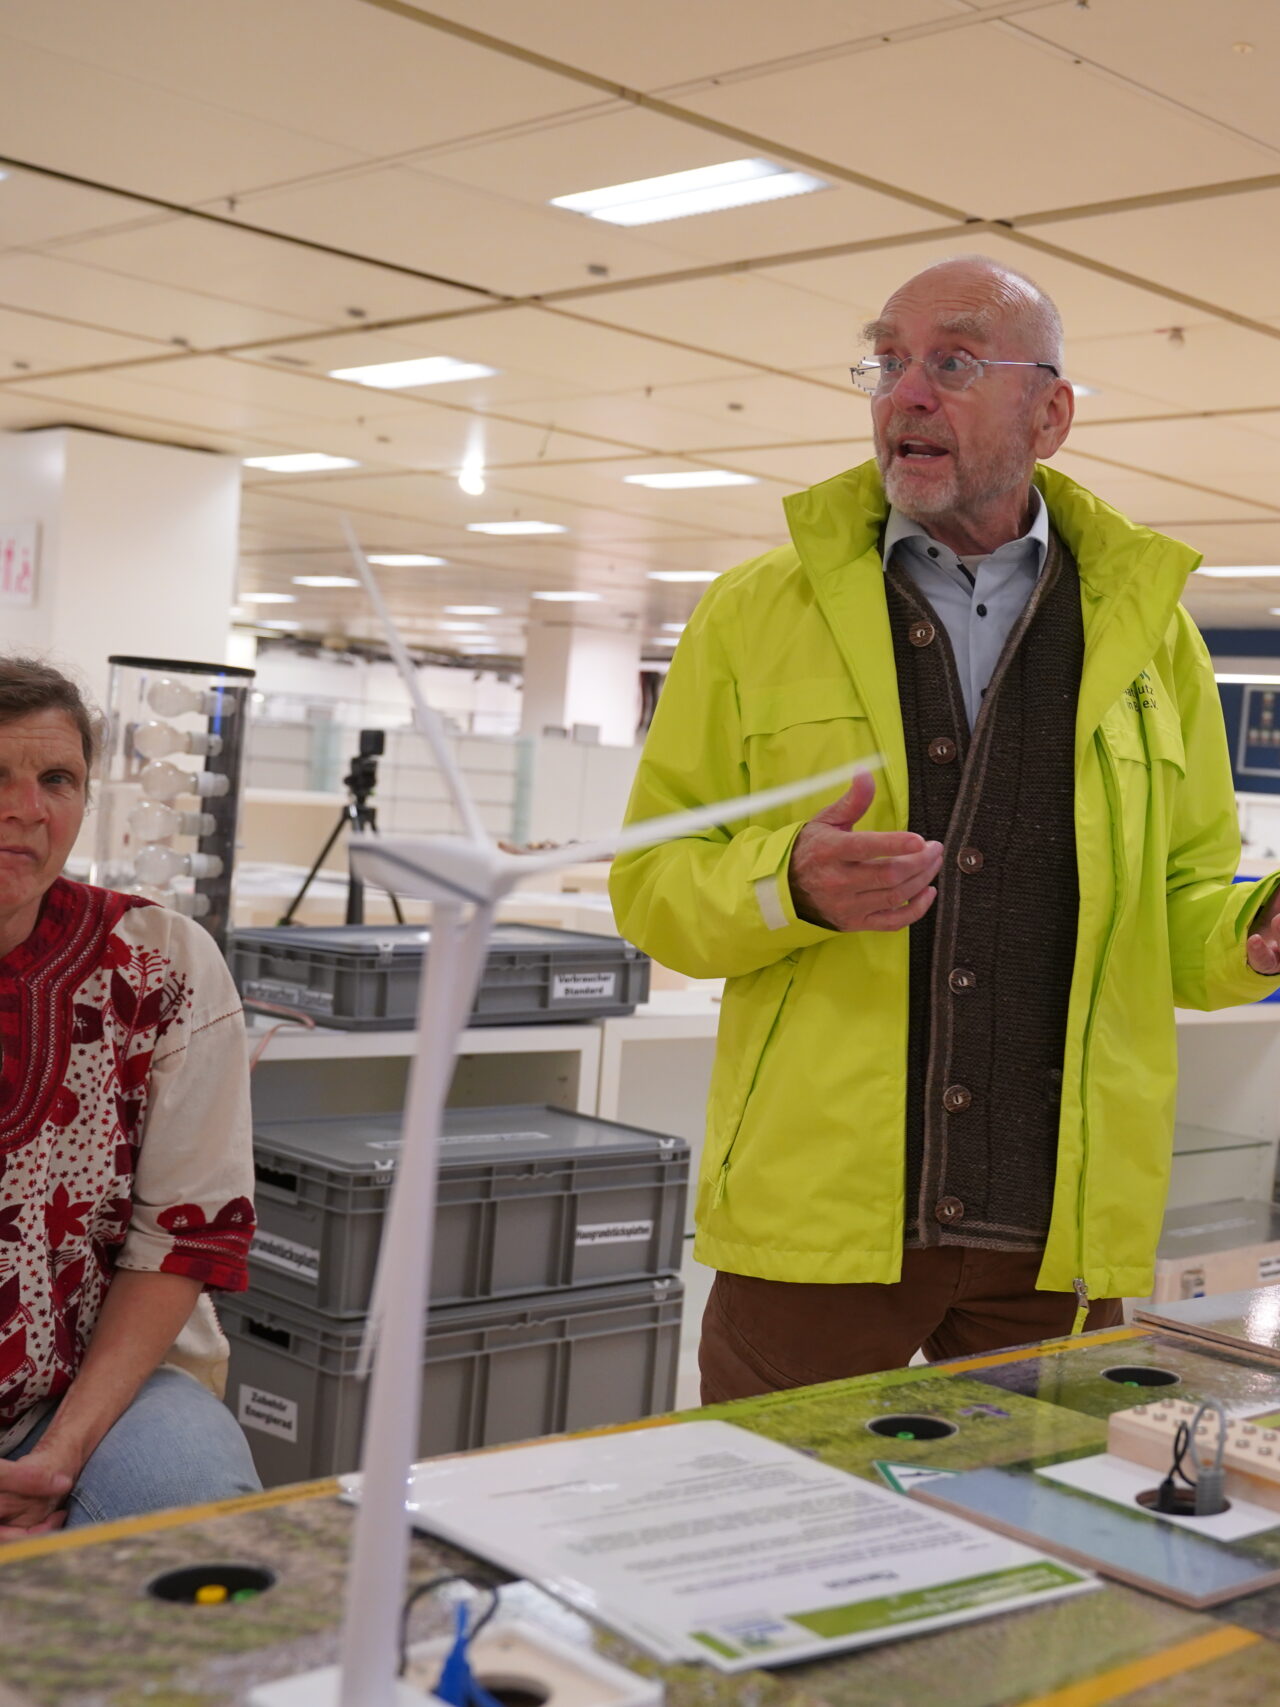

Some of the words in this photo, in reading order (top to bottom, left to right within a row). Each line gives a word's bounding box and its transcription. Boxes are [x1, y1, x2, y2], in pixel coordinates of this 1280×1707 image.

[559, 973, 612, 984] Verbraucher
[564, 985, 605, 996] Standard
[245, 1405, 293, 1431] Energierad
